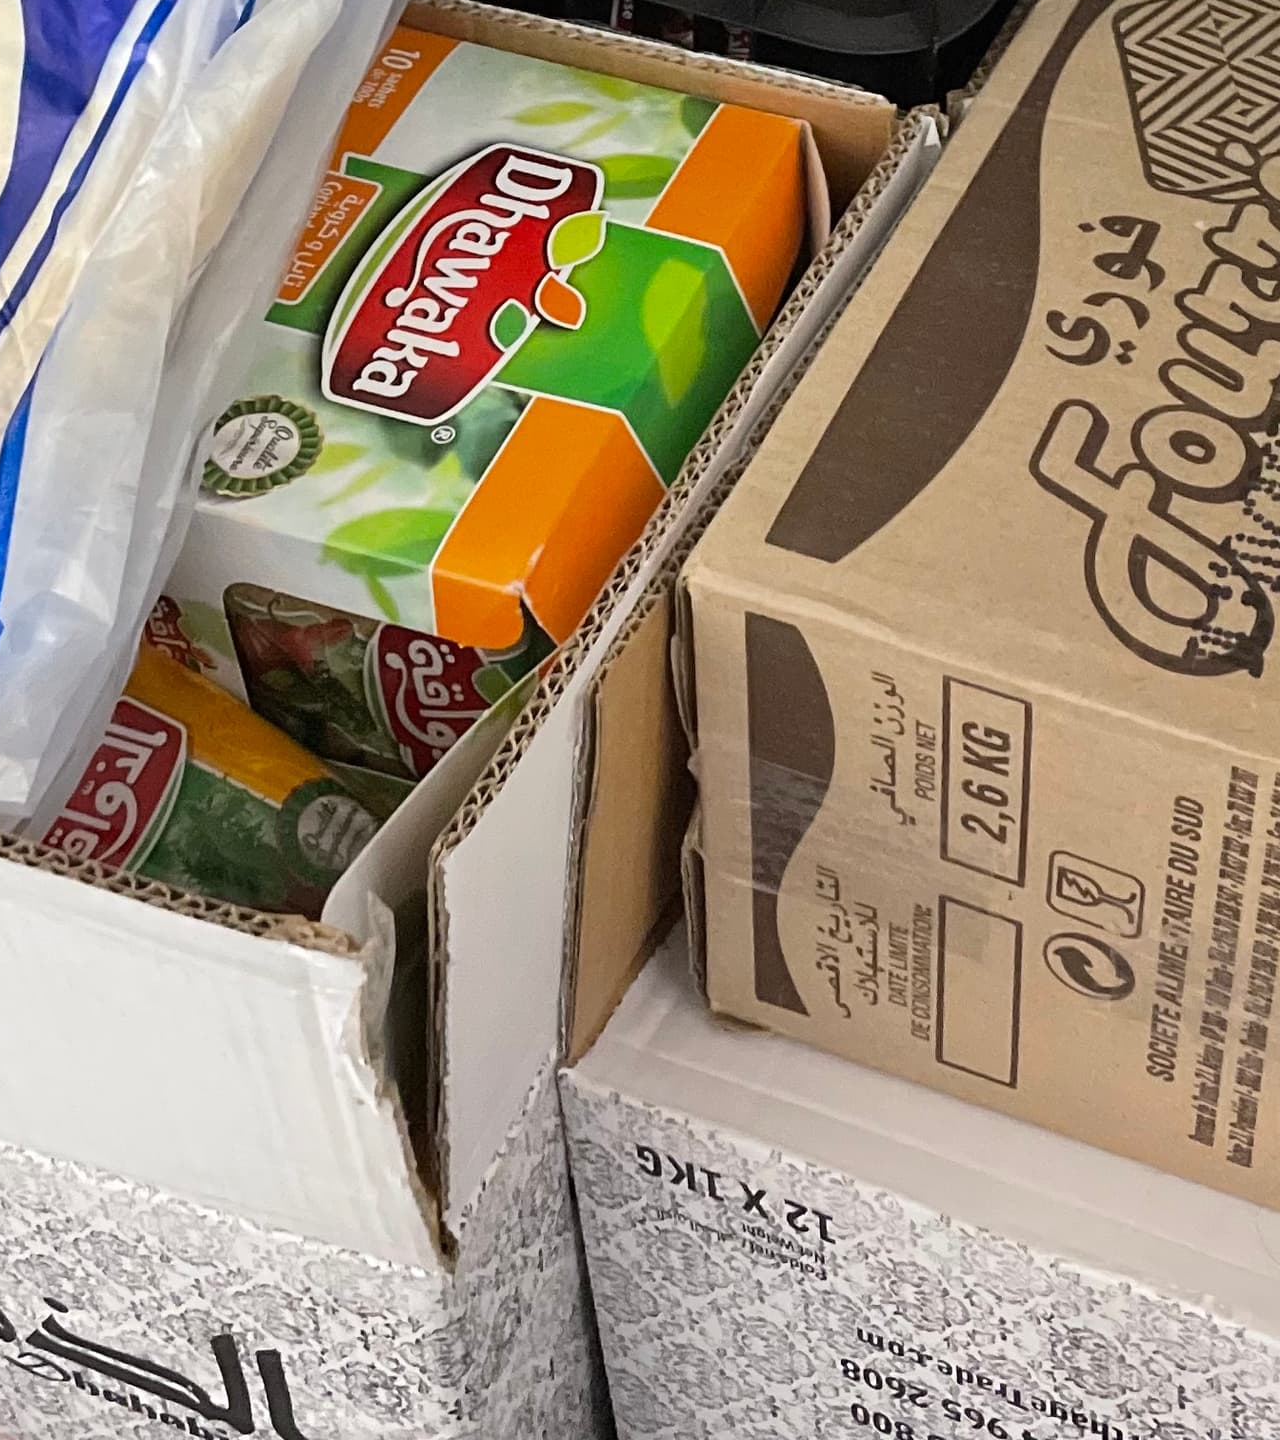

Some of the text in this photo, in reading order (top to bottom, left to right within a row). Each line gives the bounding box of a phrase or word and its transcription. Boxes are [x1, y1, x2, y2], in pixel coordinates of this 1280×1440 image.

[368, 48, 421, 109] 10 sachets
[353, 154, 573, 399] Dhawaka
[1045, 214, 1166, 366] فوري
[870, 670, 917, 827] الوزن الصافي
[914, 719, 937, 802] POIDS NET
[960, 720, 1017, 845] 2,6 KG
[816, 864, 854, 945] التاريخ
[1146, 795, 1205, 1082] SOCIETE ALIMETAIRE DU SUD
[888, 921, 909, 1007] DATE LIMITE
[911, 1021, 931, 1042] DE
[635, 1142, 836, 1244] 12 X 1KG
[841, 1358, 930, 1410] 2608
